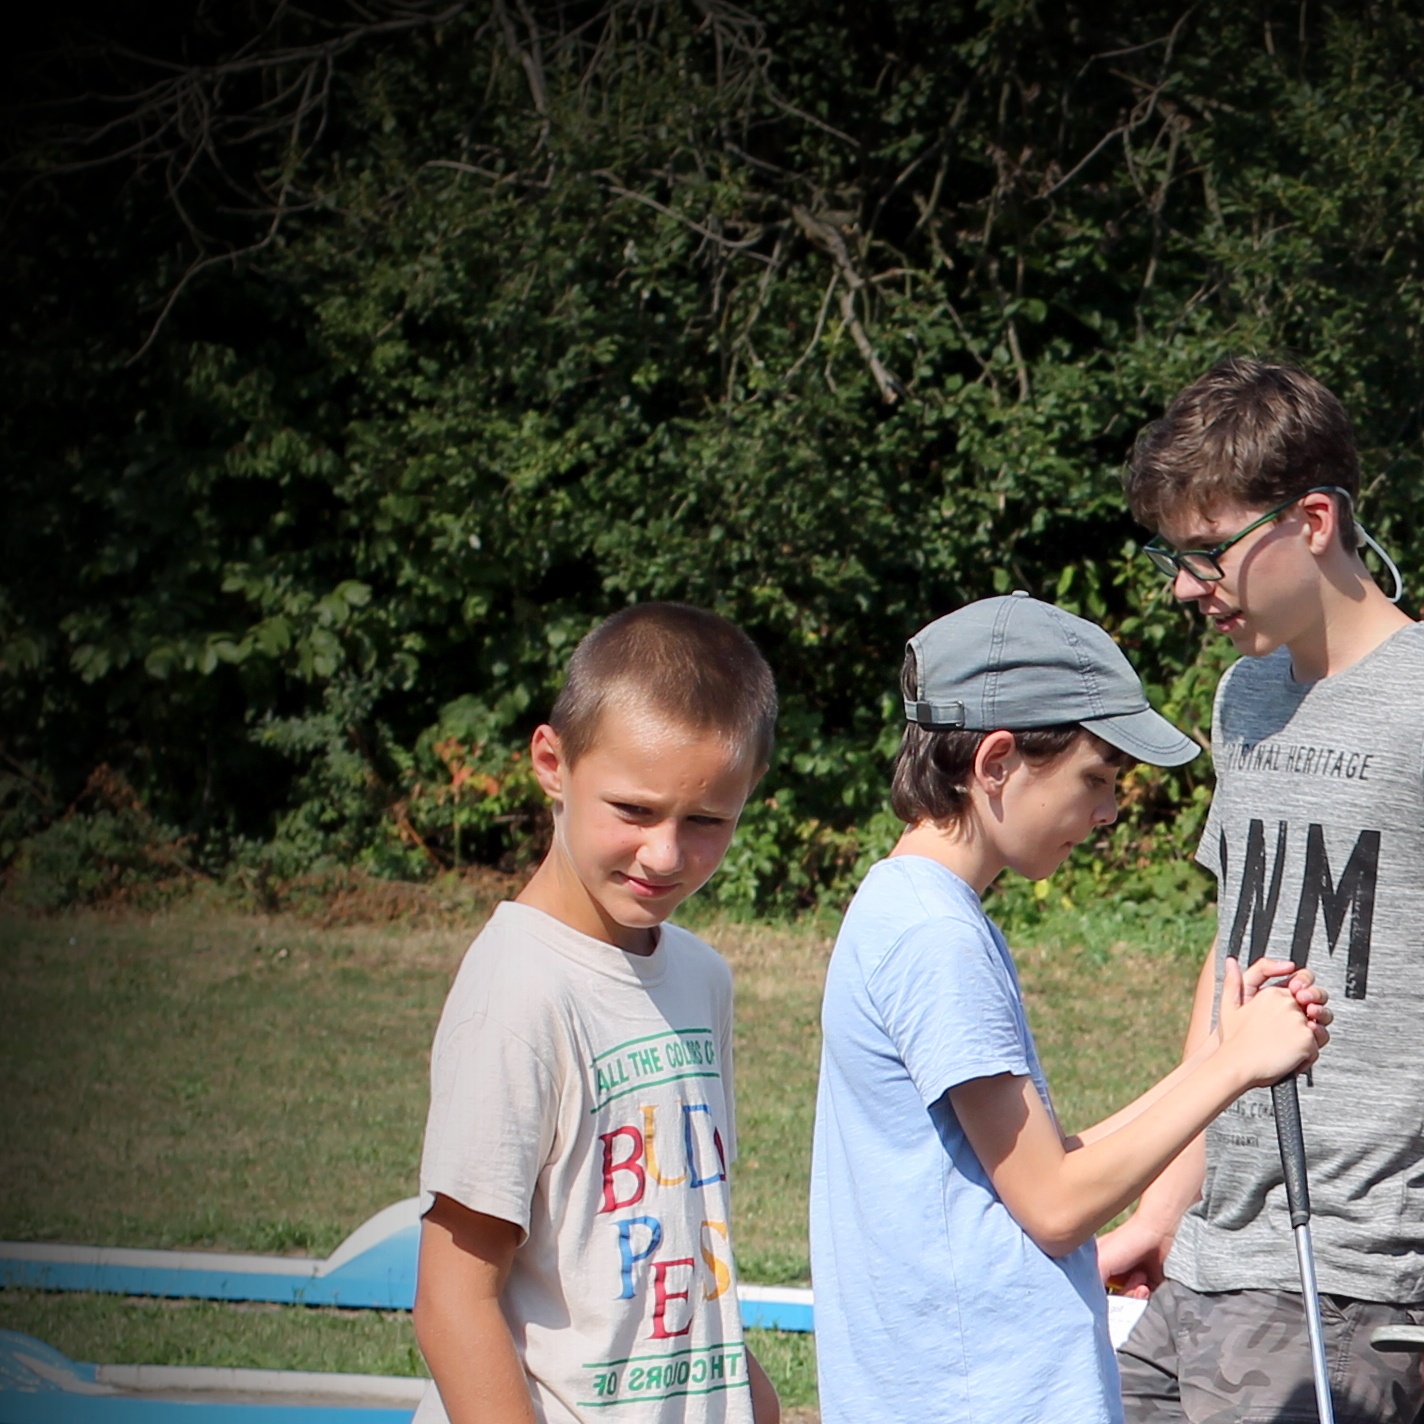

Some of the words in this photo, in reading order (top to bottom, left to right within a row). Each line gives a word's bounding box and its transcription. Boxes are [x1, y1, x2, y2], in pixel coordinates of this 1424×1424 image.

[1285, 744, 1374, 781] HERITAGE
[1219, 818, 1381, 1000] NM
[597, 1058, 630, 1095] ALL
[627, 1046, 664, 1077] THE
